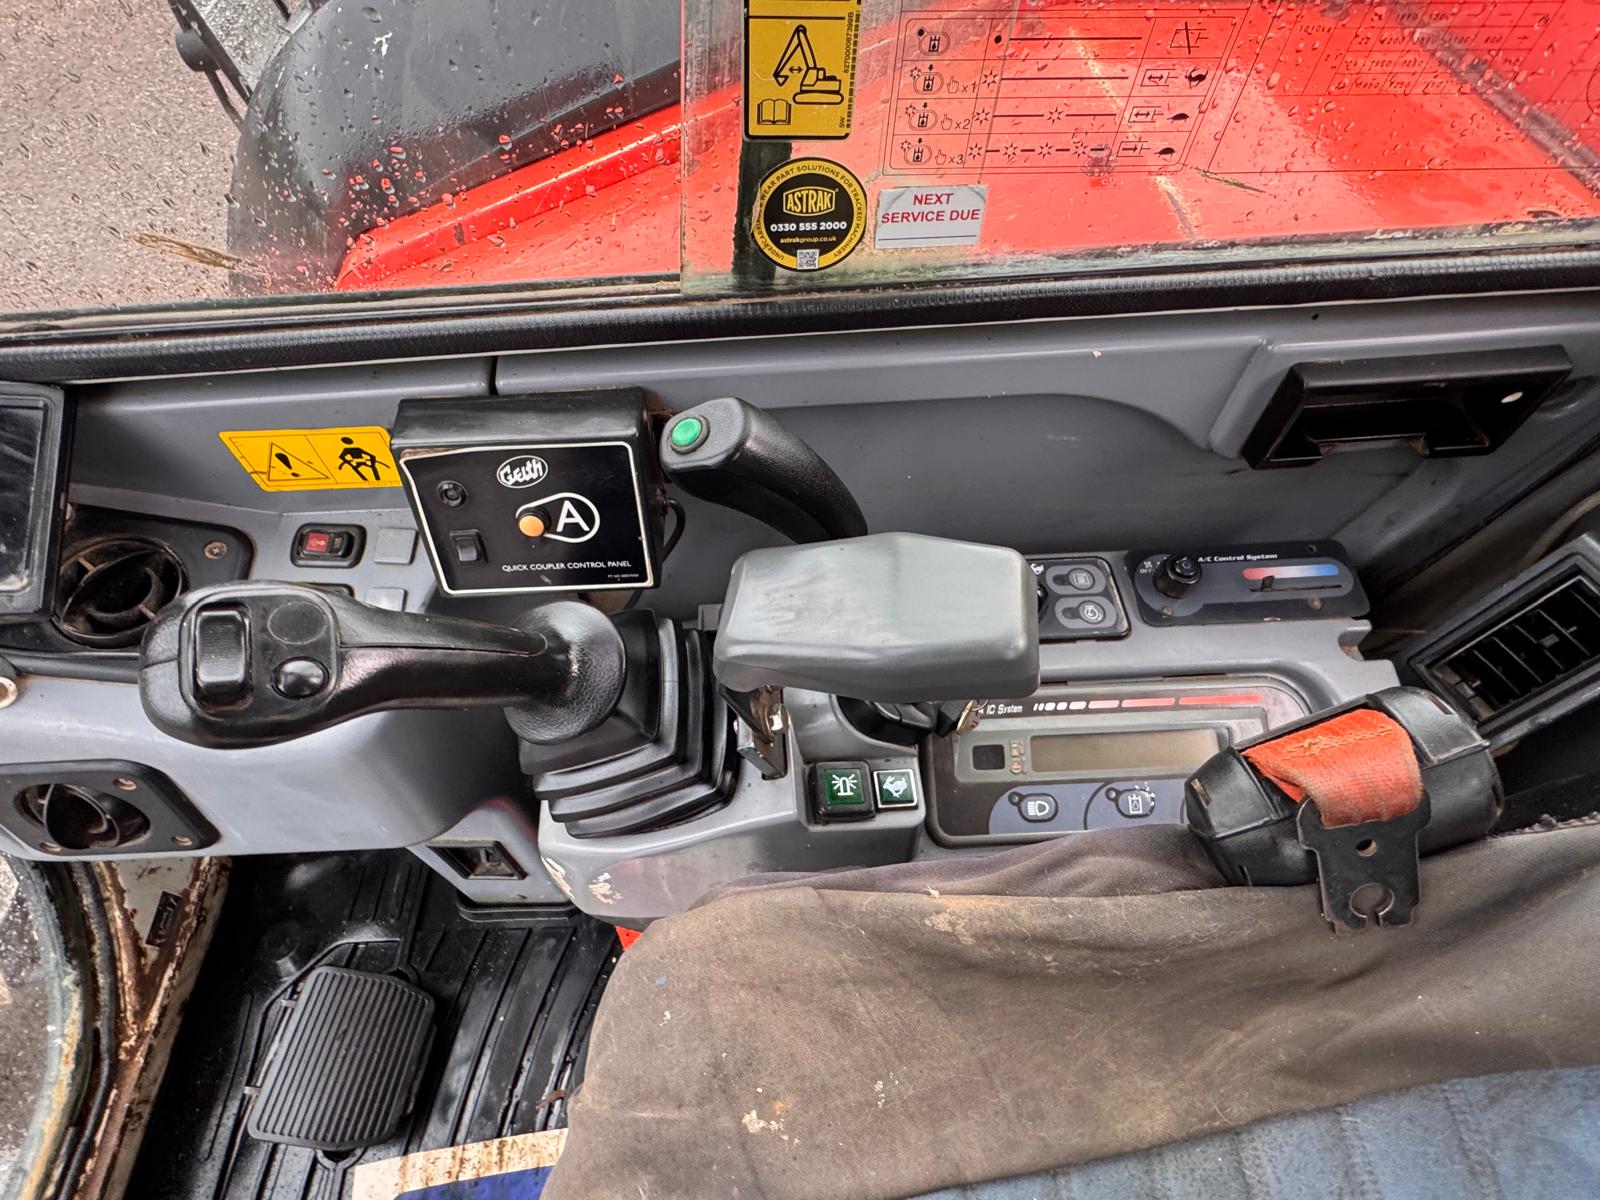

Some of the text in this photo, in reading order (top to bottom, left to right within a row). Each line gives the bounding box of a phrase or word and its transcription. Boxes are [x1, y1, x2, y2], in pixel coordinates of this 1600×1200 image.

[948, 154, 964, 165] x3
[776, 168, 795, 182] PART
[796, 164, 842, 178] SOLUTIONS
[839, 174, 854, 189] FOR
[760, 179, 777, 202] WEAR
[787, 189, 832, 213] ASTRAK
[851, 187, 863, 222] TRACKED
[913, 192, 954, 206] NEXT
[881, 209, 980, 224] SERVICE DUE
[770, 221, 848, 233] 0330 555 2000
[780, 235, 837, 245] astrakgroup.co.uk
[833, 222, 862, 259] MACHINERY
[556, 499, 591, 533] A
[1198, 553, 1278, 563] A/C Control System
[501, 560, 632, 572] QUICK COUPLER CONTROL PANEL
[997, 703, 1024, 715] System
